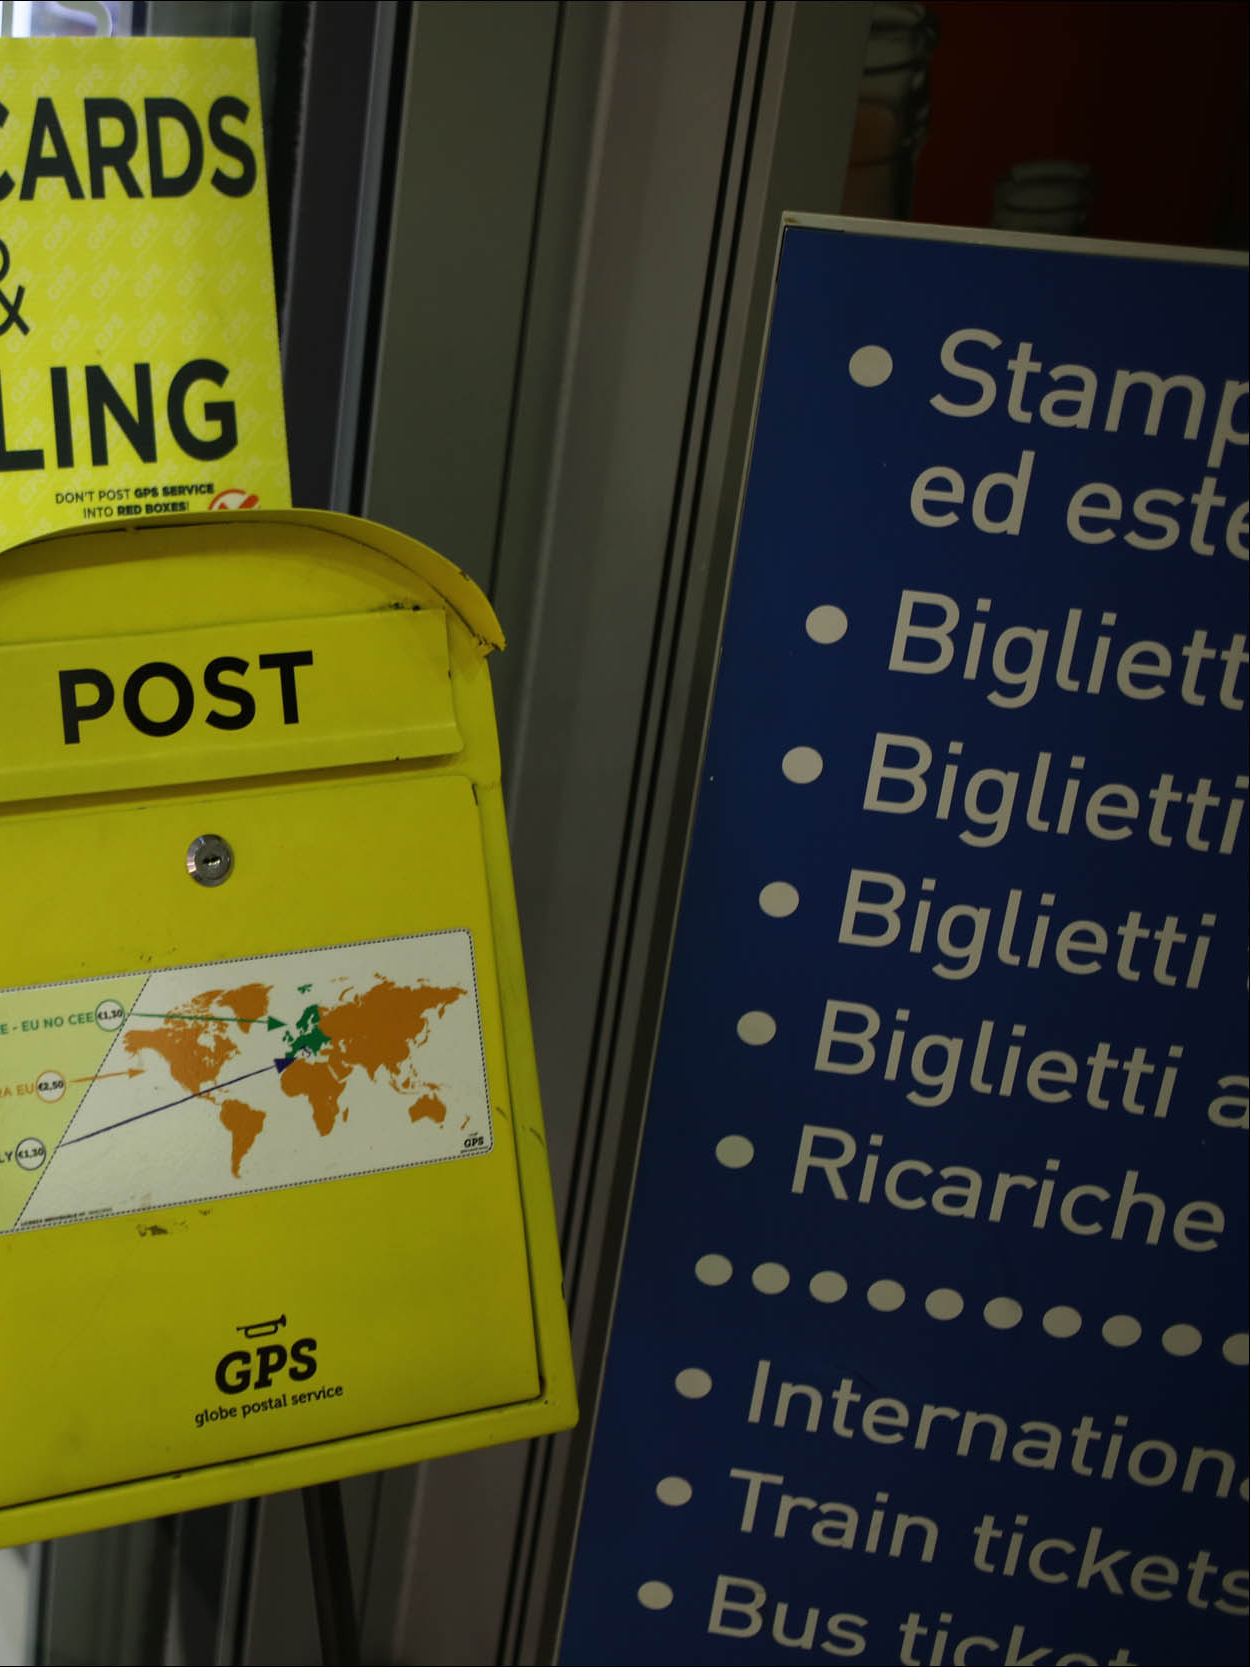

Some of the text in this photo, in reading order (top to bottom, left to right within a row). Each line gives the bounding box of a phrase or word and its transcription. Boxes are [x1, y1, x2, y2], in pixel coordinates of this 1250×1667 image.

[930, 328, 1249, 468] Stamp
[55, 483, 214, 504] DON'T POST GPS SERVICE
[83, 501, 190, 519] INTO RED BOXES!
[909, 450, 1035, 535] ed
[888, 589, 1249, 710] Bigliett
[59, 650, 313, 745] POST
[863, 732, 1249, 855] Biglietti
[838, 868, 1217, 990] Biglietti
[21, 1020, 39, 1032] EU
[43, 1017, 64, 1029] NO
[68, 1012, 95, 1024] CEE
[814, 998, 1184, 1119] Biglietti
[17, 1084, 34, 1096] EU
[791, 1124, 1226, 1252] Ricariche
[195, 1385, 344, 1428] globe postal service
[215, 1338, 317, 1395] GPS
[747, 1359, 1249, 1502] Internation
[730, 1468, 1249, 1616] Train tickets
[706, 1575, 869, 1657] Bus
